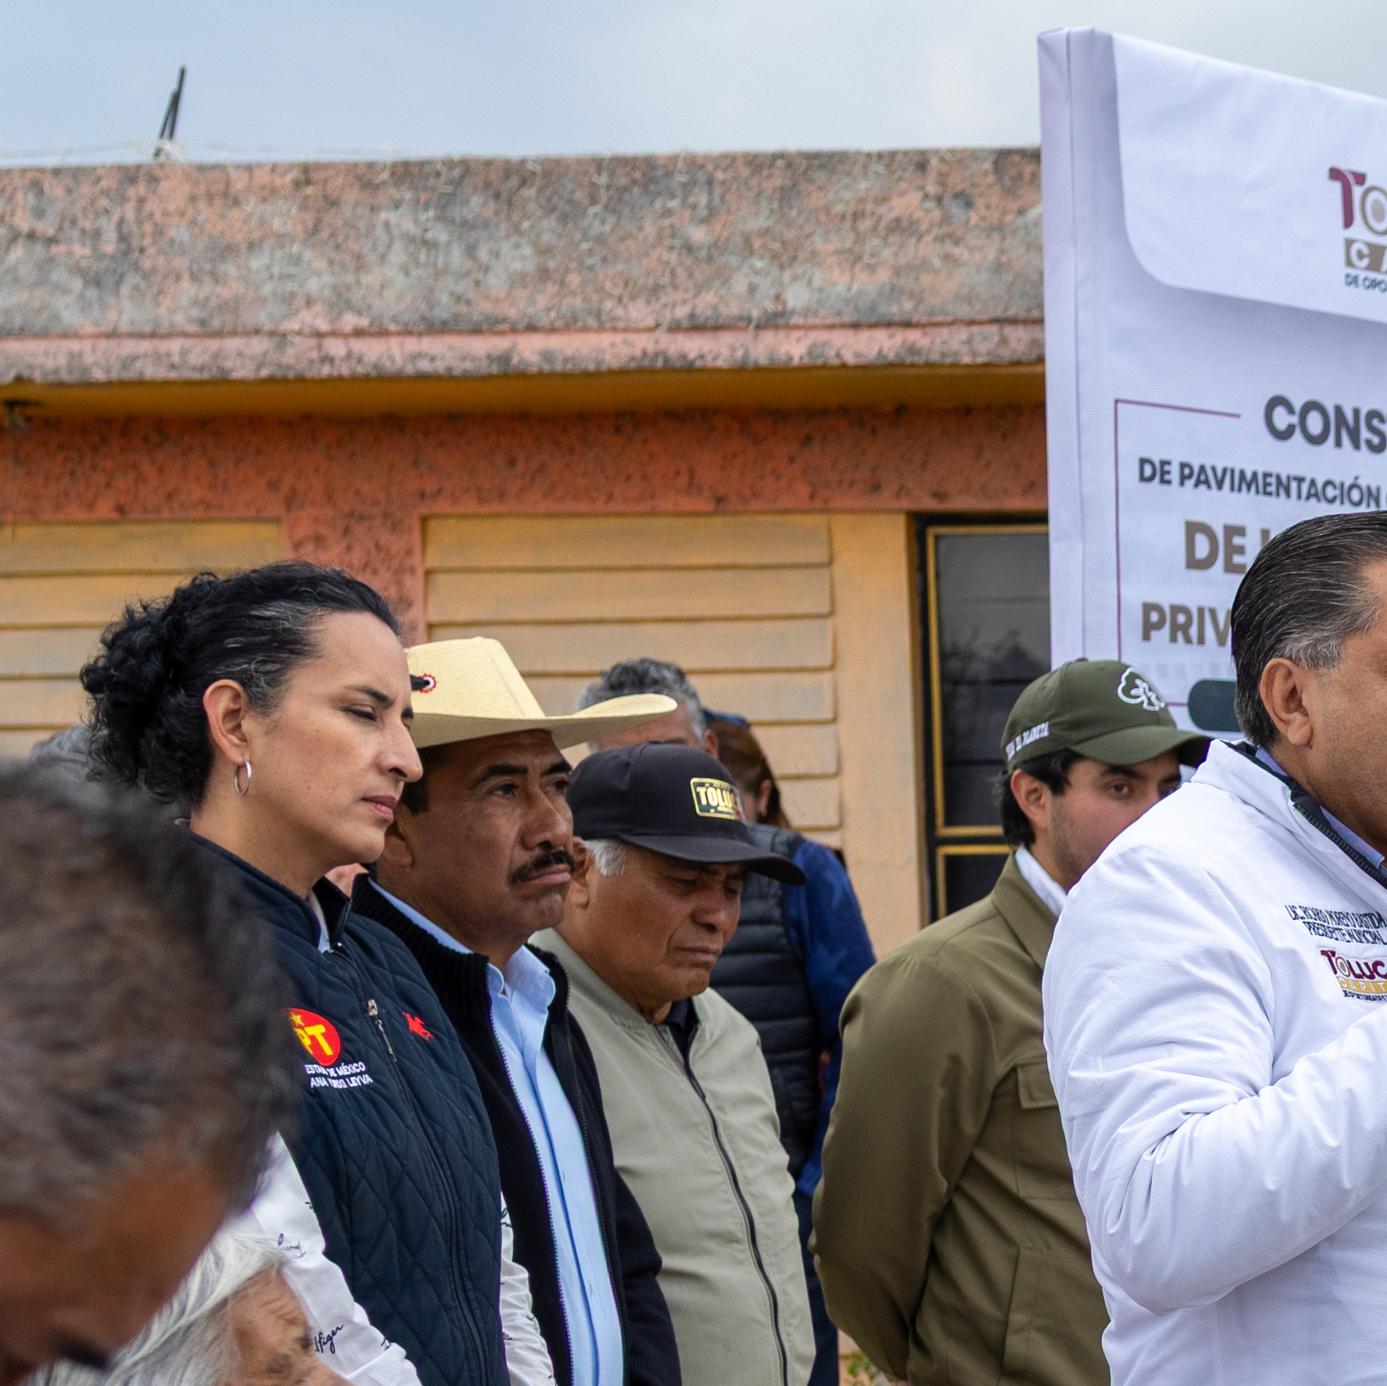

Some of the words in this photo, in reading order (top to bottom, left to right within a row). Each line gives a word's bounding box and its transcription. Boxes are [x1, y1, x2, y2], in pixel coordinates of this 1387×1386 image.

[1345, 272, 1360, 287] DE
[1138, 456, 1175, 485] DE
[1178, 461, 1381, 510] PAVIMENTACIÓN
[1185, 519, 1247, 575] DE
[1141, 601, 1231, 647] PRIV
[310, 1076, 329, 1088] ANA
[346, 1073, 374, 1088] LEYVA
[336, 1061, 366, 1077] MÉXICO
